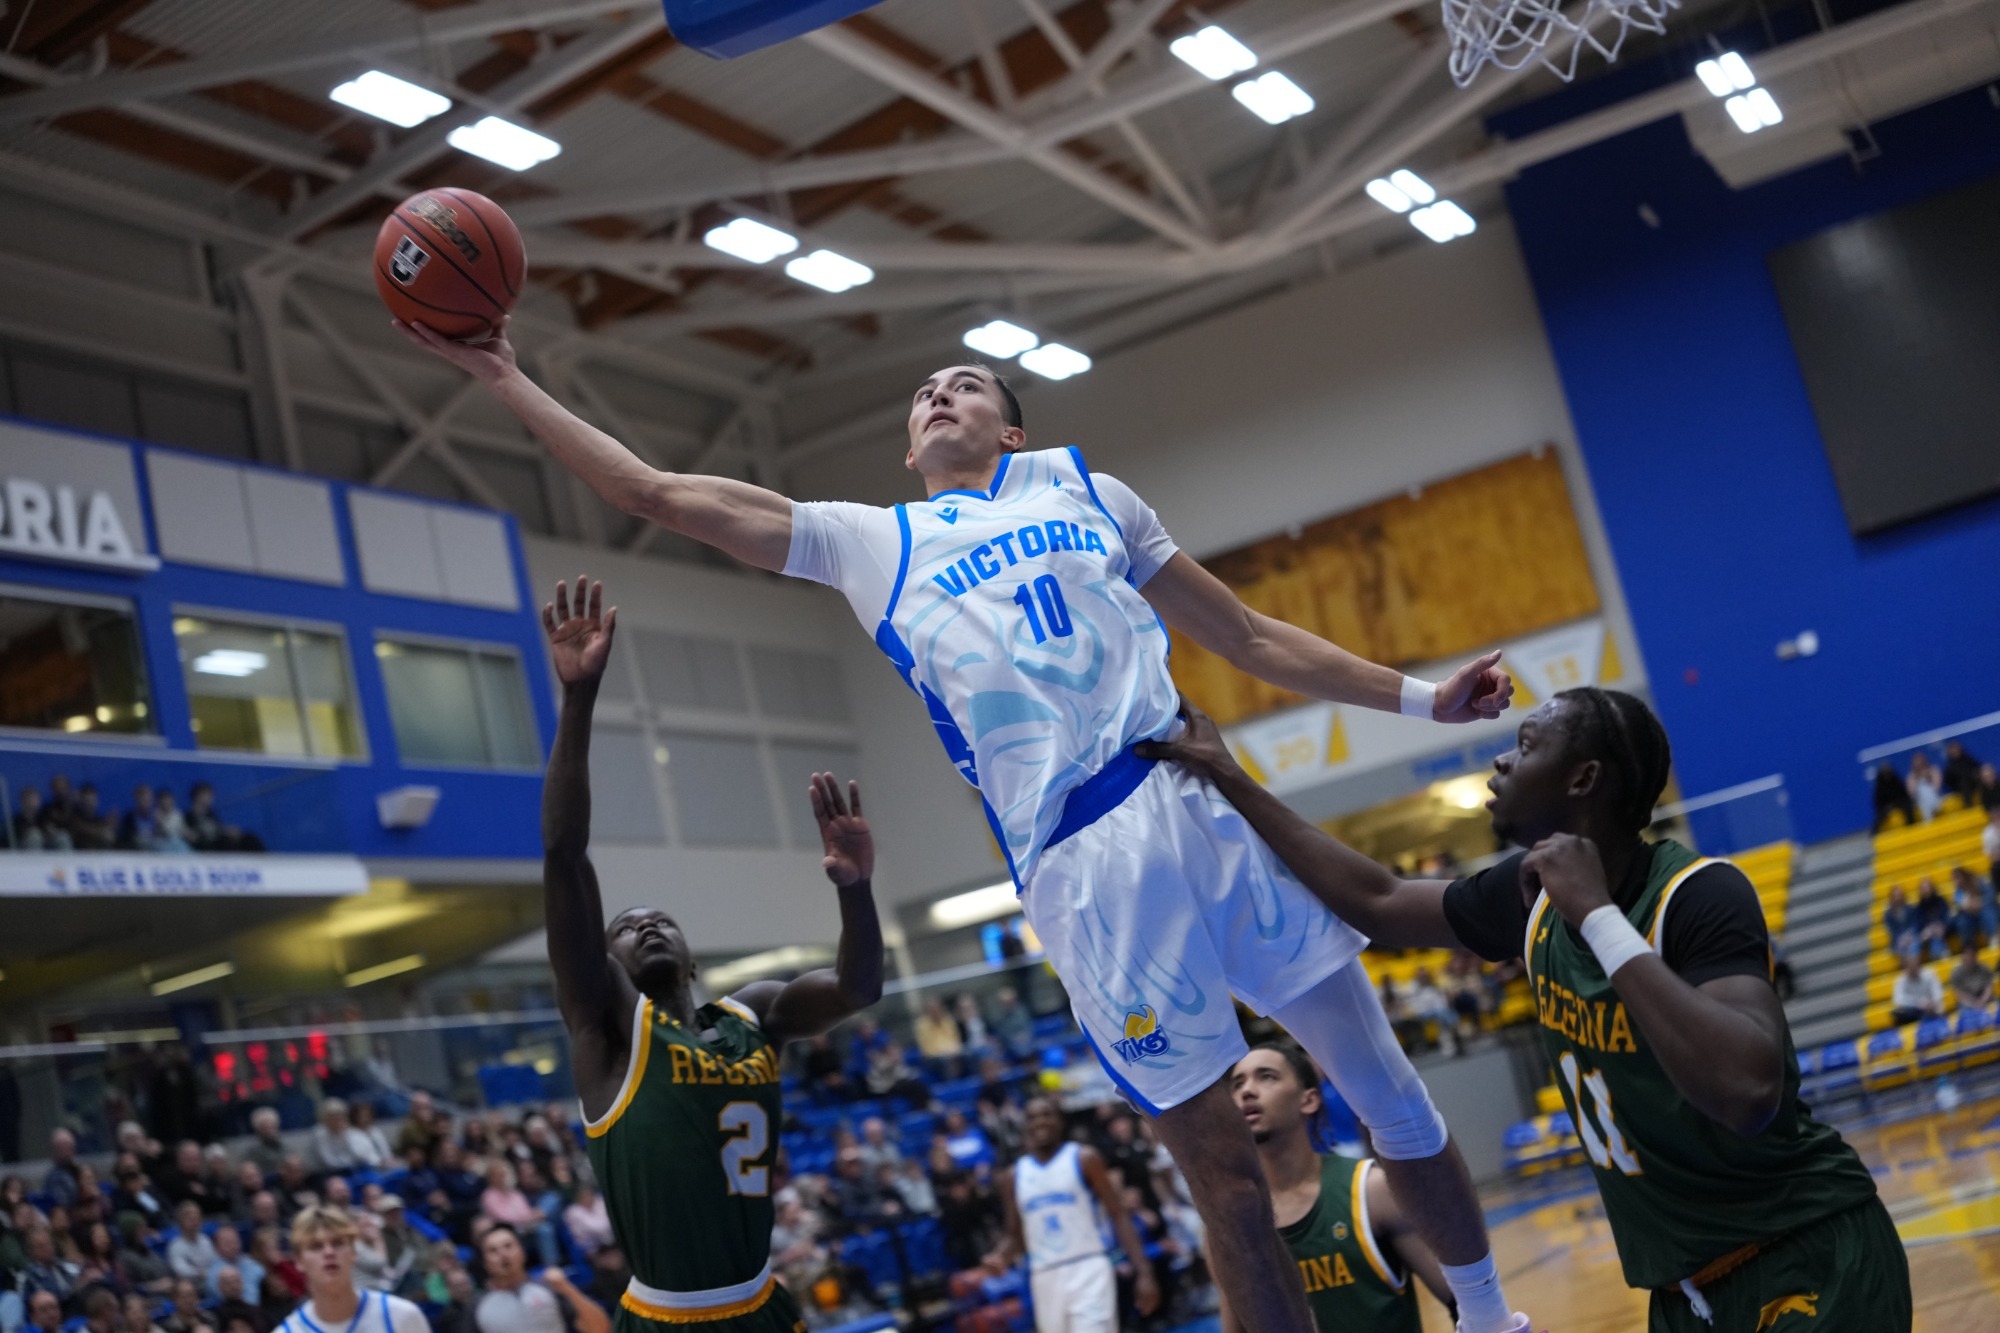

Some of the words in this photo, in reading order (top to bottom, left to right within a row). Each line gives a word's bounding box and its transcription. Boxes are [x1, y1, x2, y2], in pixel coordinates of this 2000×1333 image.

[0, 476, 134, 560] RIA
[932, 519, 1108, 598] VICTORIA
[1012, 573, 1074, 645] 10
[717, 1100, 770, 1197] 2
